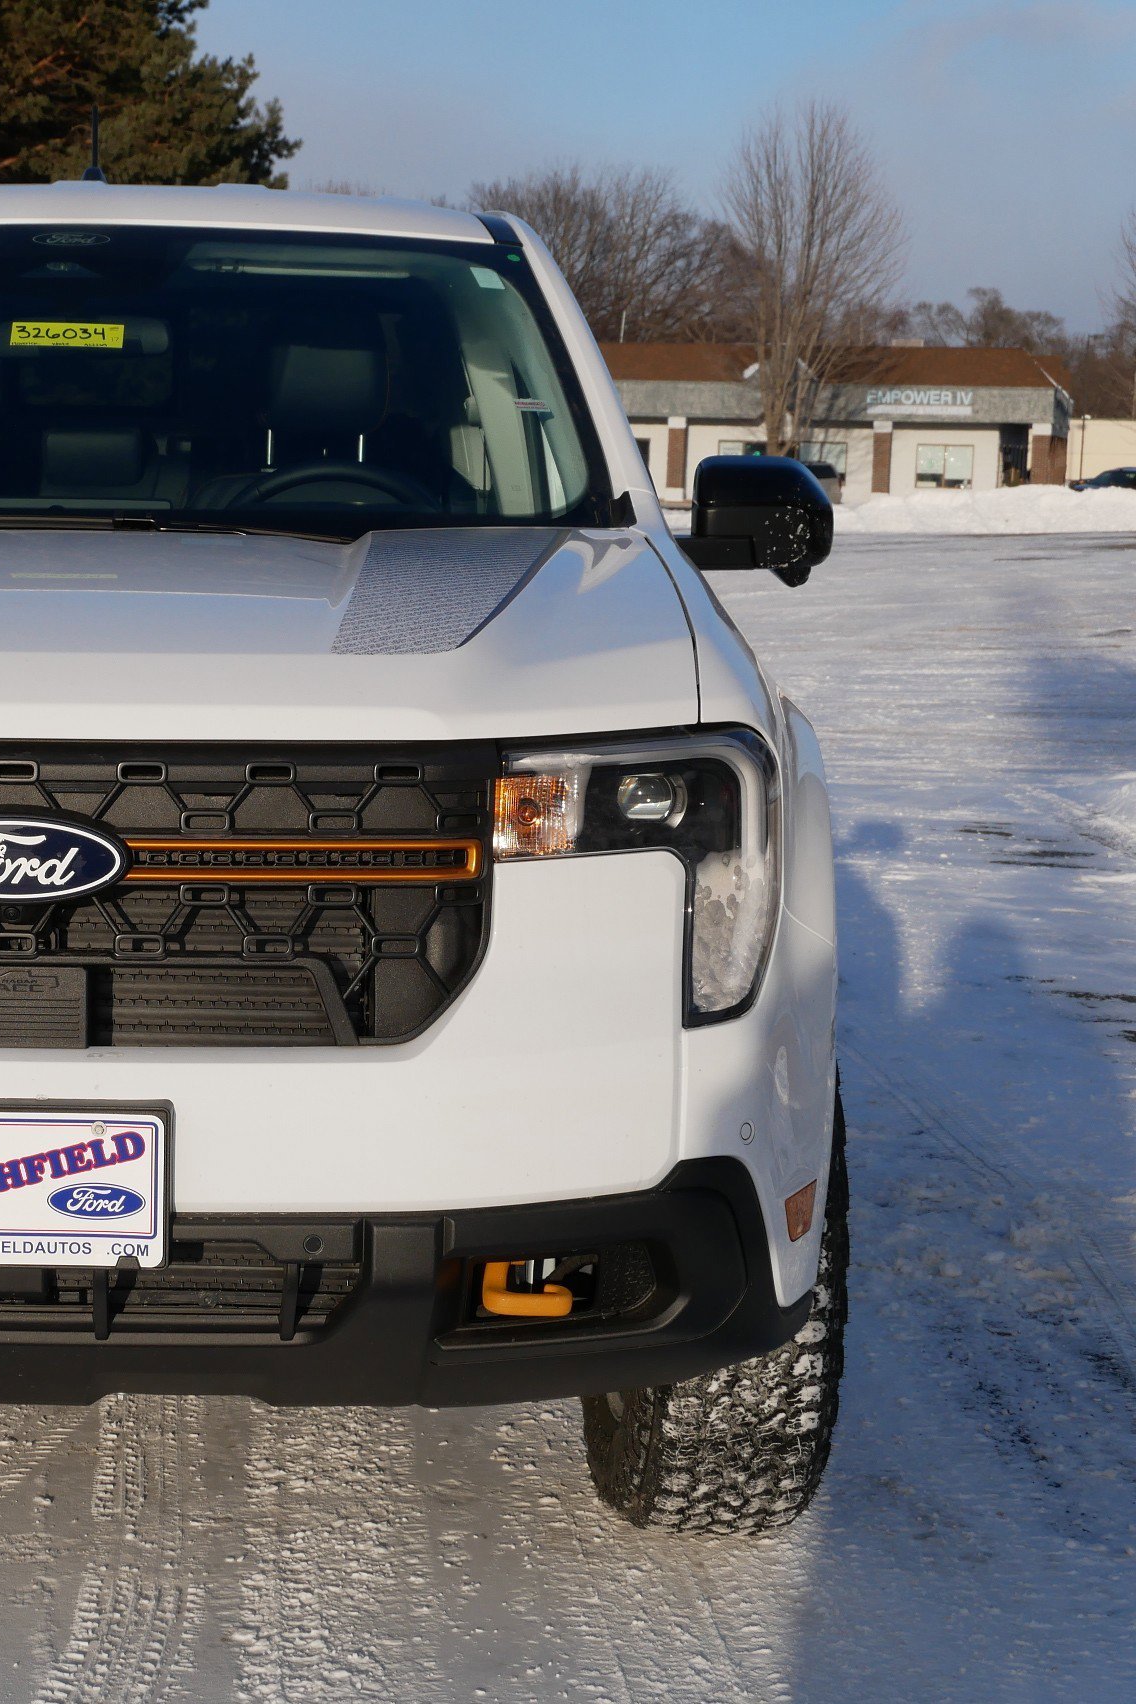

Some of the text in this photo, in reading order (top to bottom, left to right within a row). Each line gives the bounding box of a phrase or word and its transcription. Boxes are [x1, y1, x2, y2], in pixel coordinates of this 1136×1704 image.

[46, 233, 97, 244] Ford
[16, 325, 106, 340] 326034
[866, 390, 973, 405] EMPOWER IV
[66, 1188, 125, 1213] Ford
[107, 1242, 149, 1257] .COM
